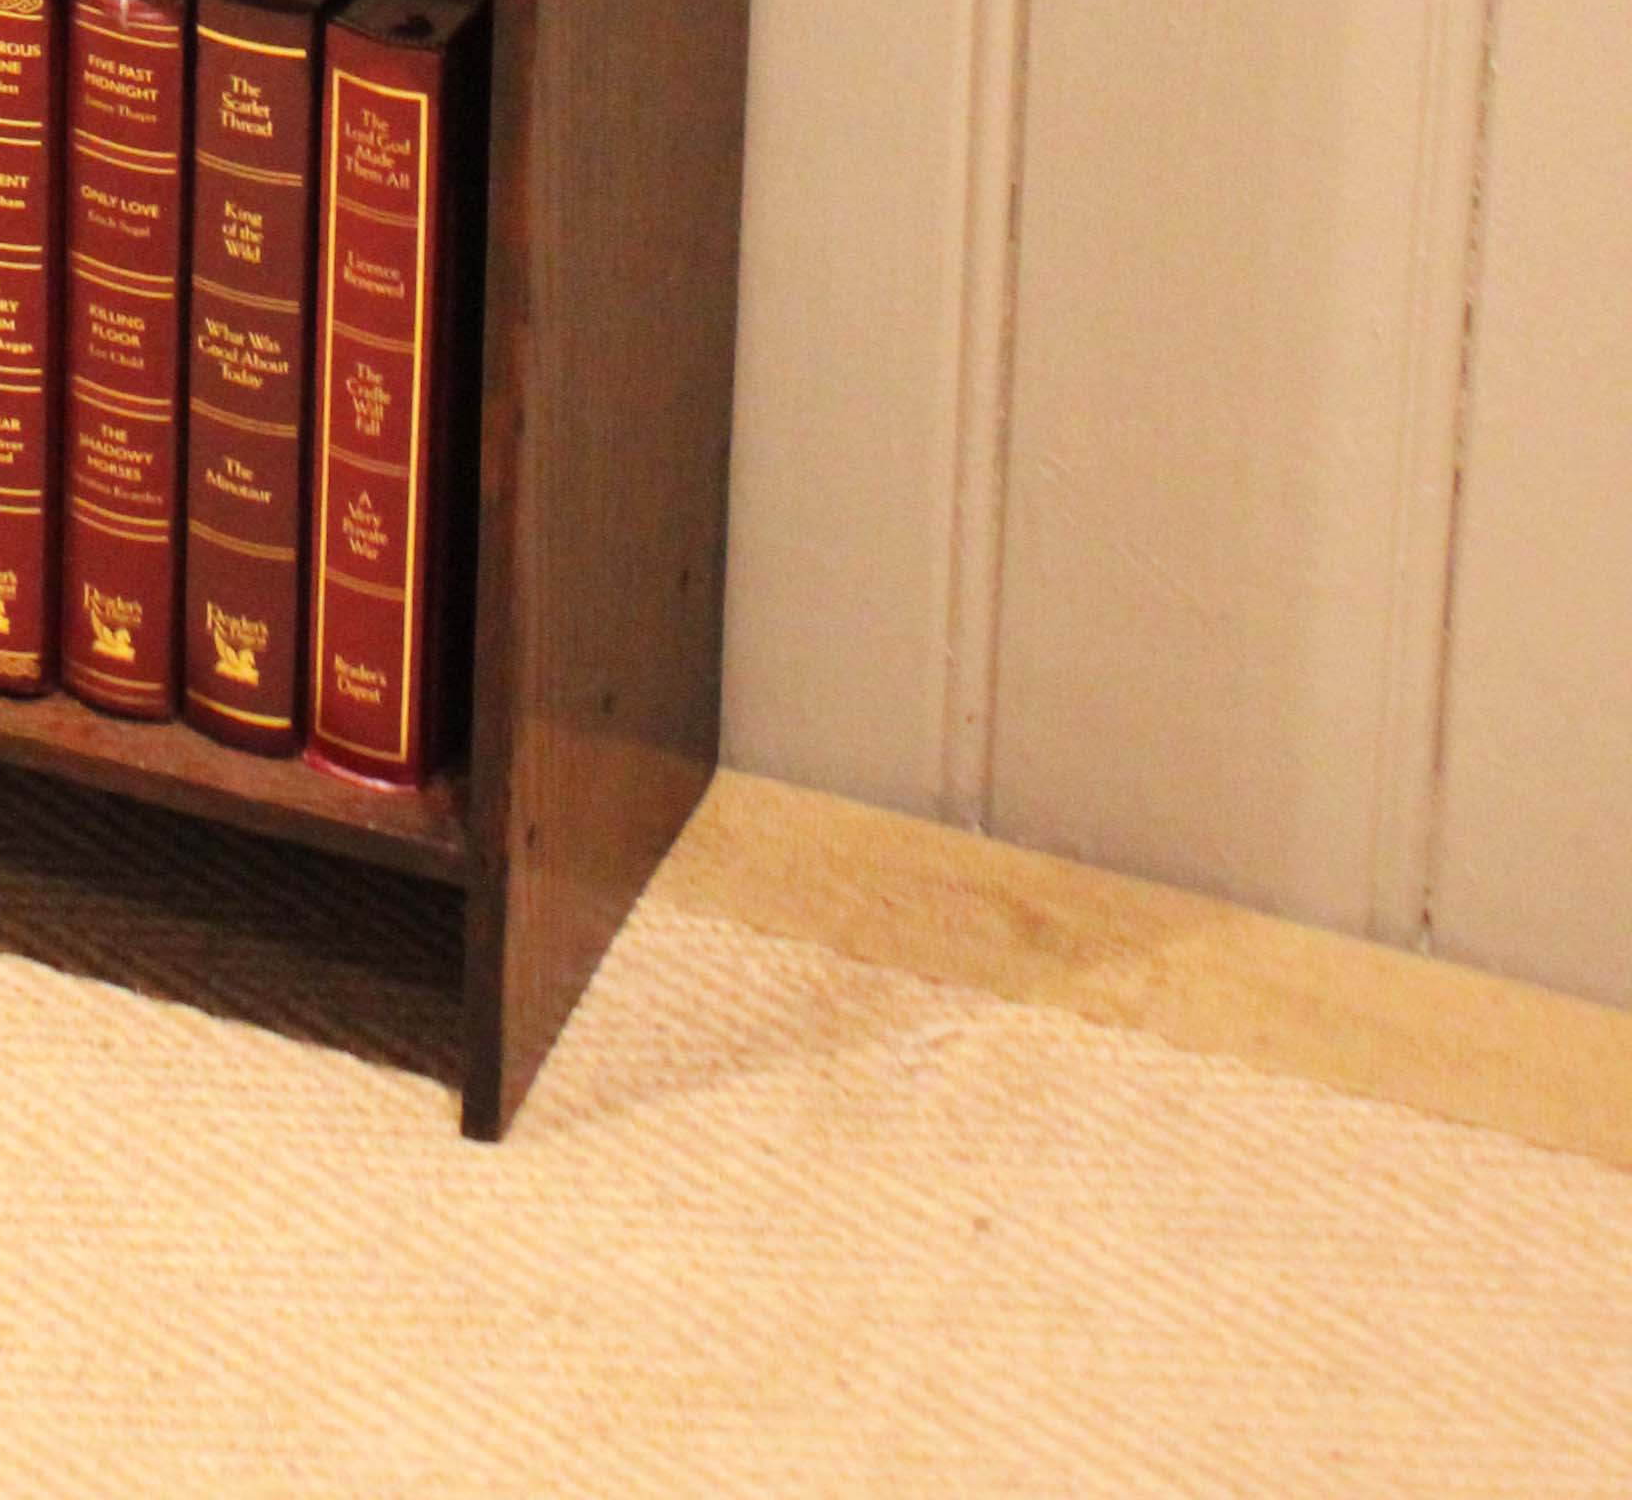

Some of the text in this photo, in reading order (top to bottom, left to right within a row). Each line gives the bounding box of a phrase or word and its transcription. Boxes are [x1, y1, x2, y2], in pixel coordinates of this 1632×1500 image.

[87, 53, 154, 83] FIVE PAST
[83, 69, 158, 102] MIDNIGHT
[230, 74, 262, 98] The
[221, 92, 270, 120] Scarlet
[362, 108, 389, 132] The
[220, 109, 273, 138] Thread
[387, 172, 410, 190] All
[80, 184, 159, 220] ONLY LOVE
[225, 200, 263, 228] King
[239, 225, 264, 244] the
[224, 238, 262, 265] Wild
[89, 304, 145, 332] KILLING
[91, 322, 141, 348] FLOOR
[205, 317, 282, 355] What Was
[101, 424, 127, 444] THE
